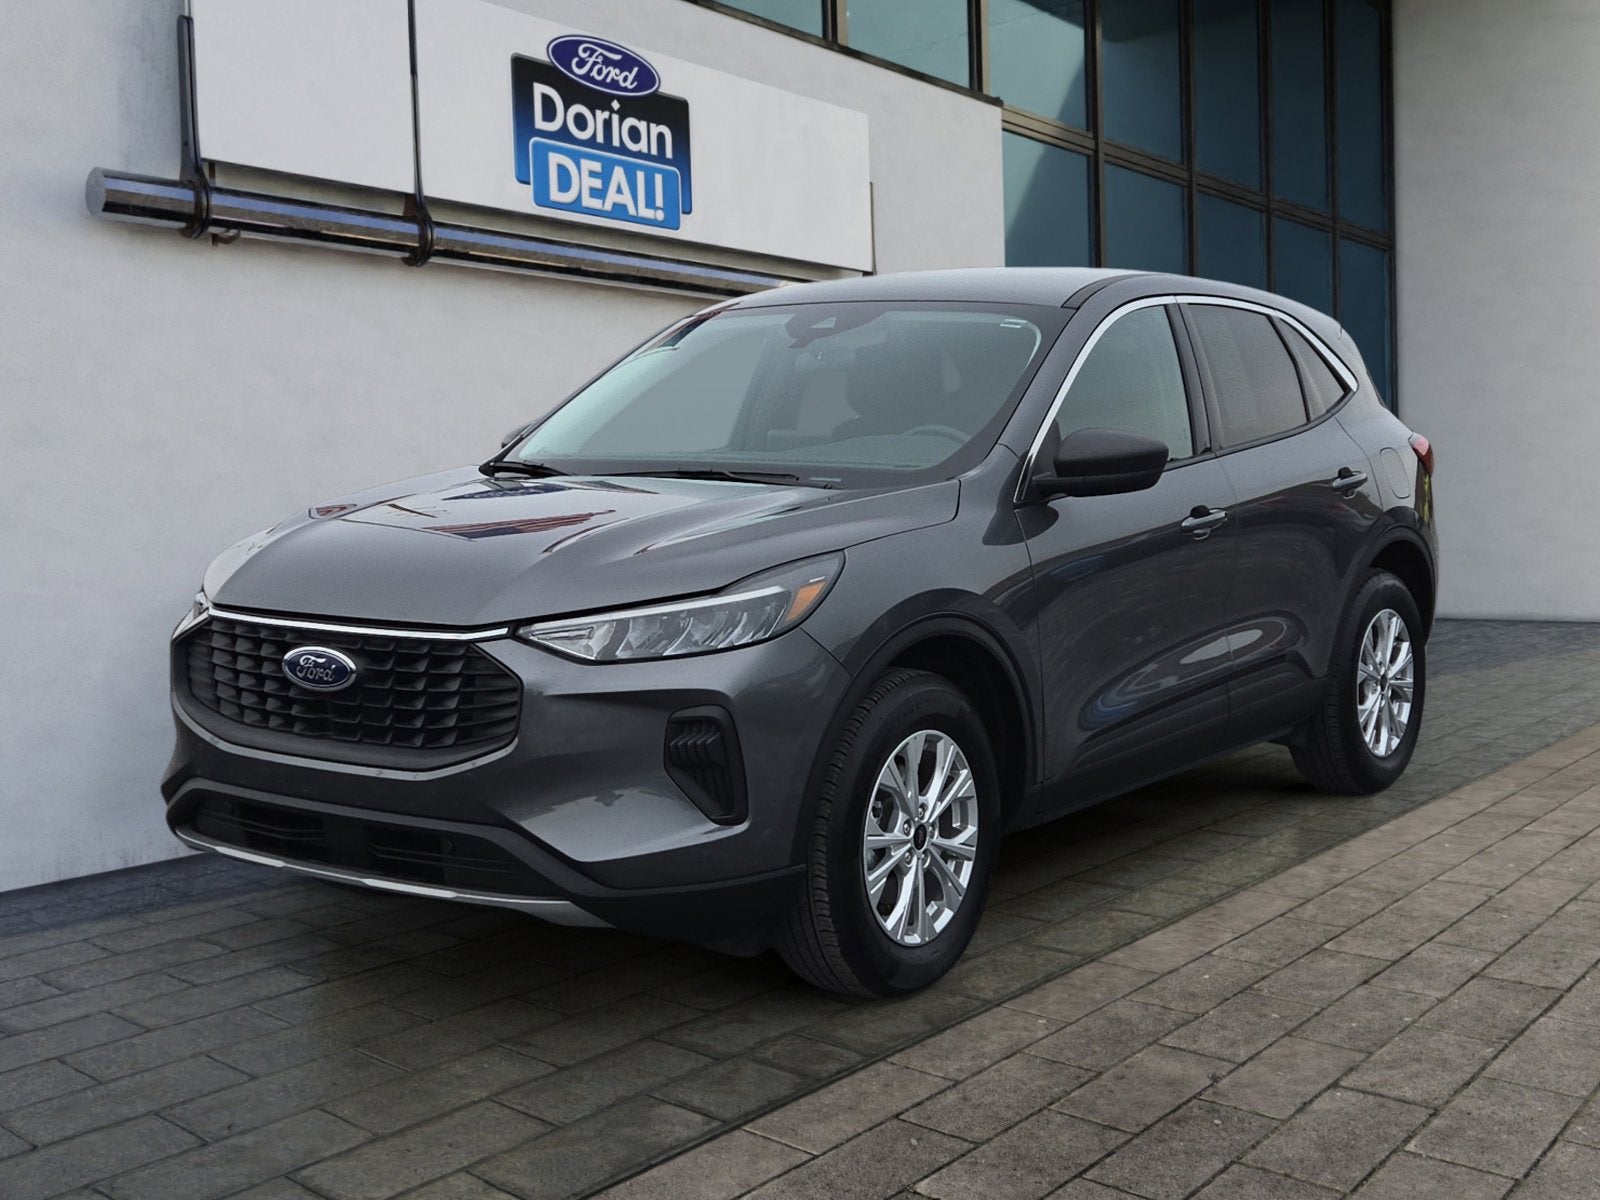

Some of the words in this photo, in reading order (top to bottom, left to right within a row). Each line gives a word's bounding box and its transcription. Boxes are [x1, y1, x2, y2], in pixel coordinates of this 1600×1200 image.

[571, 43, 639, 89] Ford
[532, 82, 673, 159] Dorian
[548, 152, 665, 222] DEAL!
[296, 655, 336, 681] Ford
